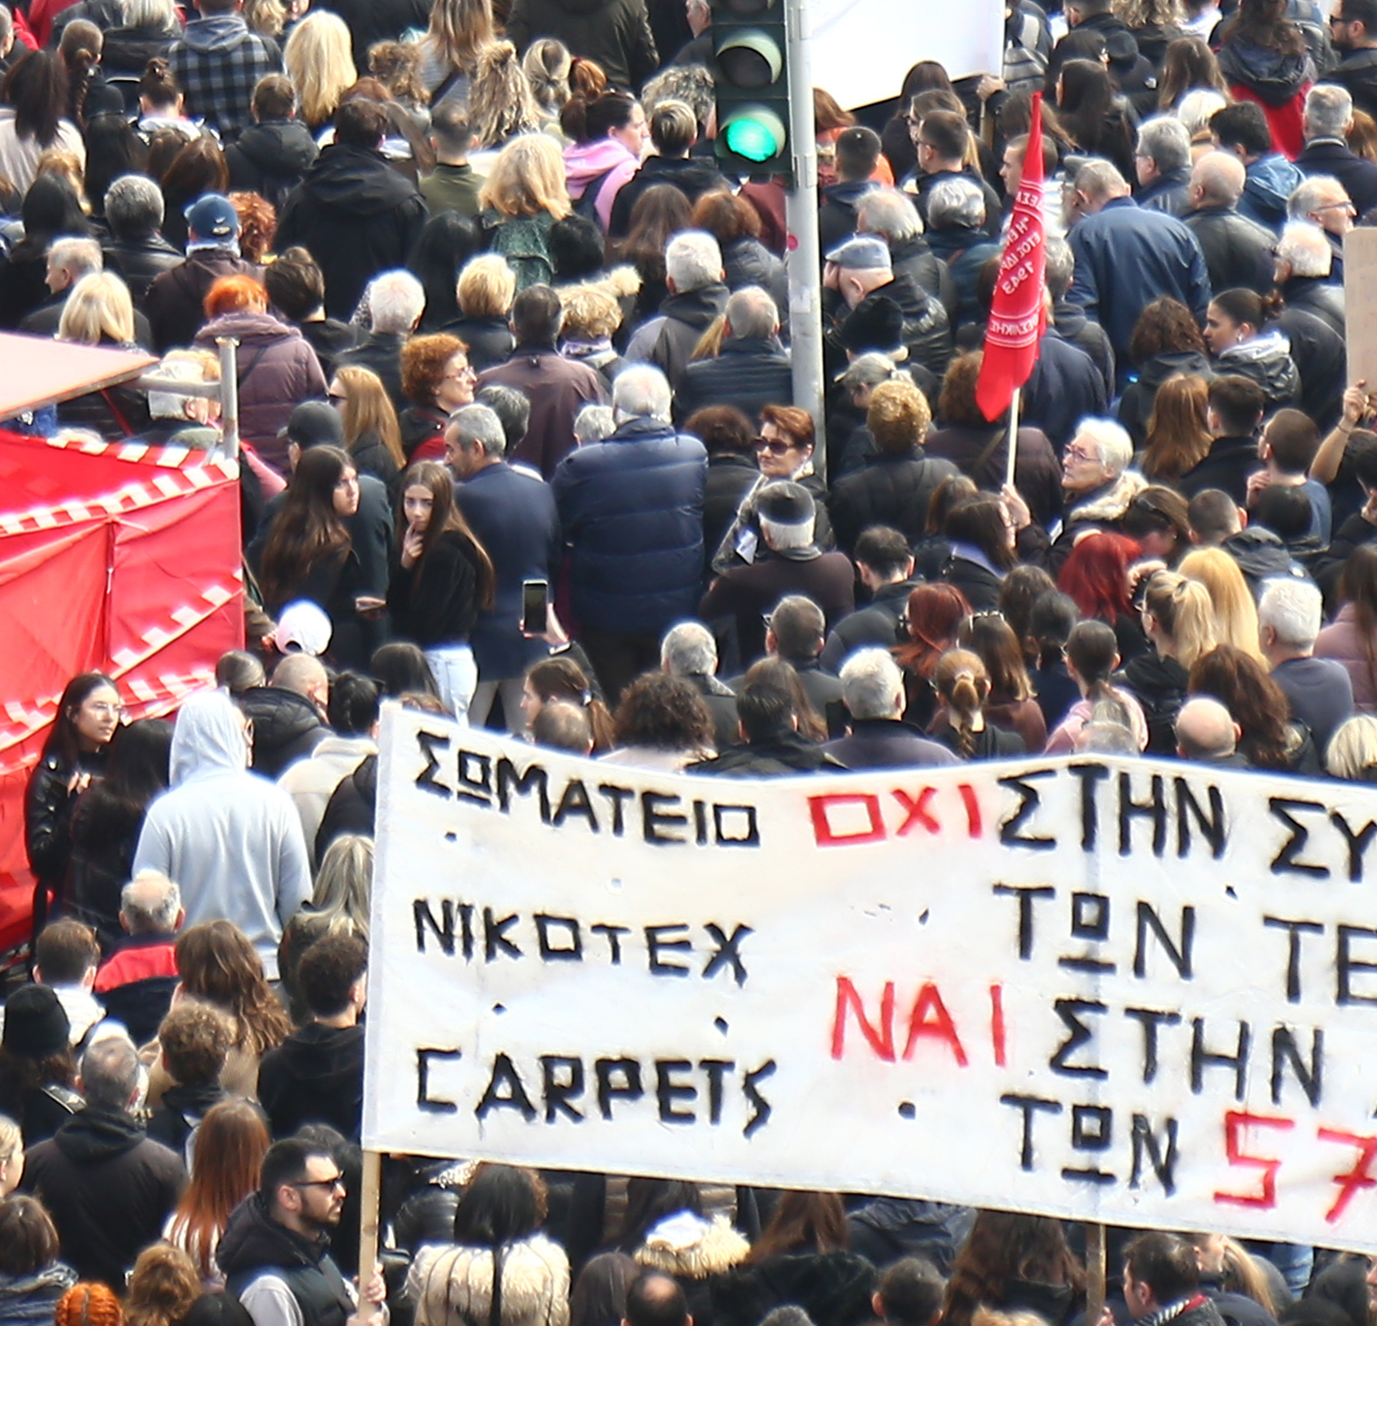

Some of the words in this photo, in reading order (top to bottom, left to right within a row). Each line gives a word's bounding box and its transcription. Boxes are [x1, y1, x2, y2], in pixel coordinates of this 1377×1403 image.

[414, 729, 761, 848] ΣΩΜΑΤΕΙΟ
[809, 782, 983, 848] ΟΧΙ
[998, 762, 1228, 860] ΣΤΗΝ
[993, 882, 1197, 981] ΤΩΝ
[416, 1046, 778, 1140] CARPETS
[831, 974, 1007, 1068] ΝΑΙ
[1049, 998, 1324, 1108] ΣΤΗΝ
[999, 1092, 1179, 1198] ΤΩΝ
